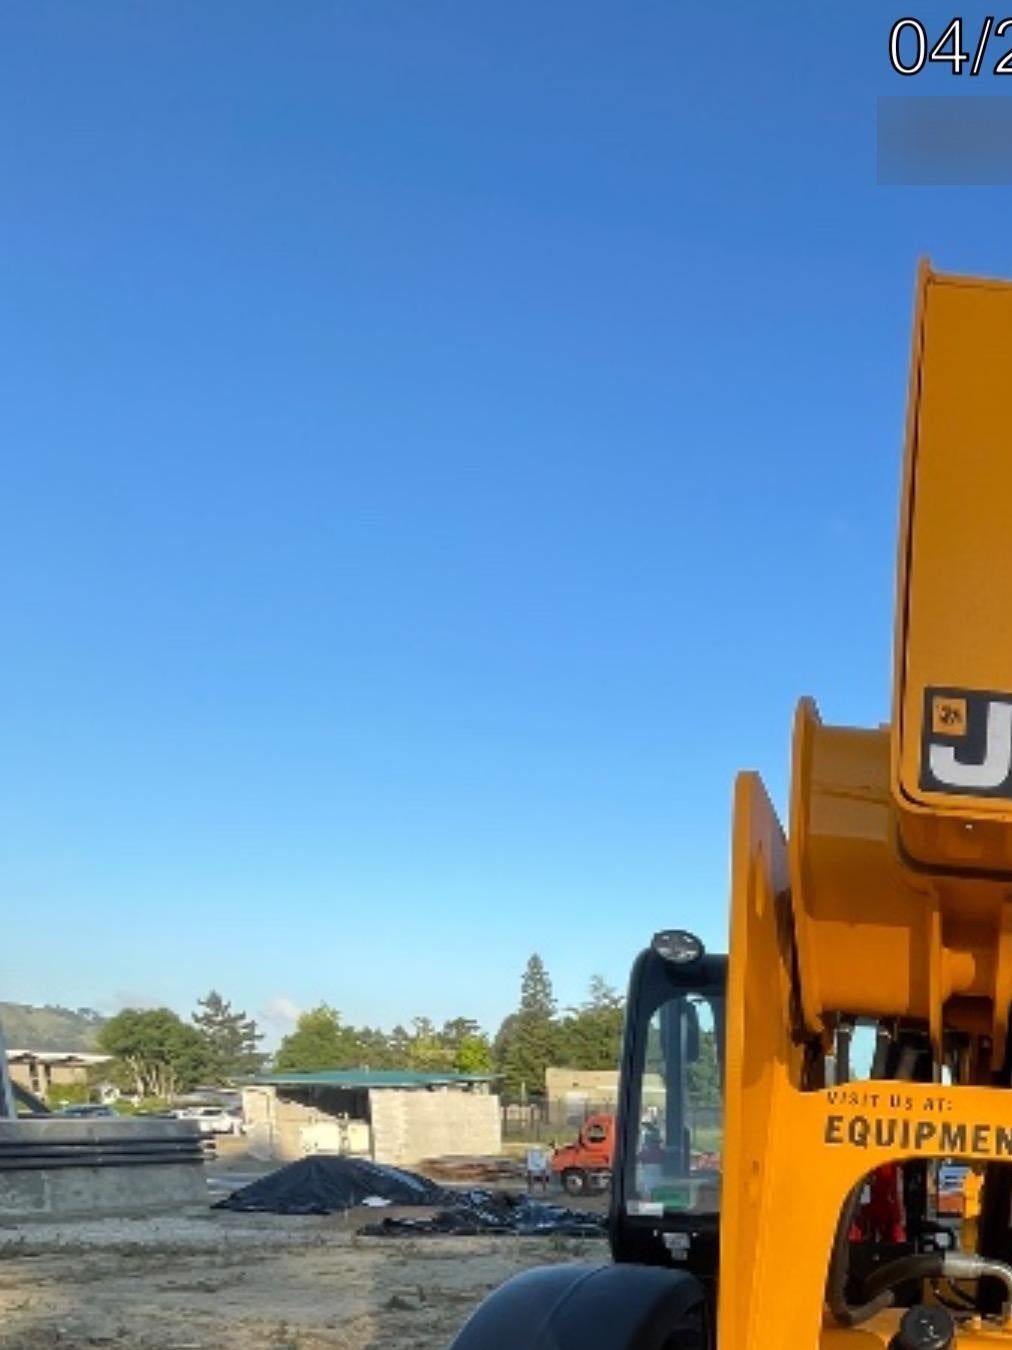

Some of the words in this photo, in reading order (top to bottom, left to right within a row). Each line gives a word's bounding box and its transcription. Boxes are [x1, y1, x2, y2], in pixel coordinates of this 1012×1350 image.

[827, 1091, 880, 1107] VISIT
[890, 1094, 913, 1111] US
[923, 1097, 953, 1113] AT:
